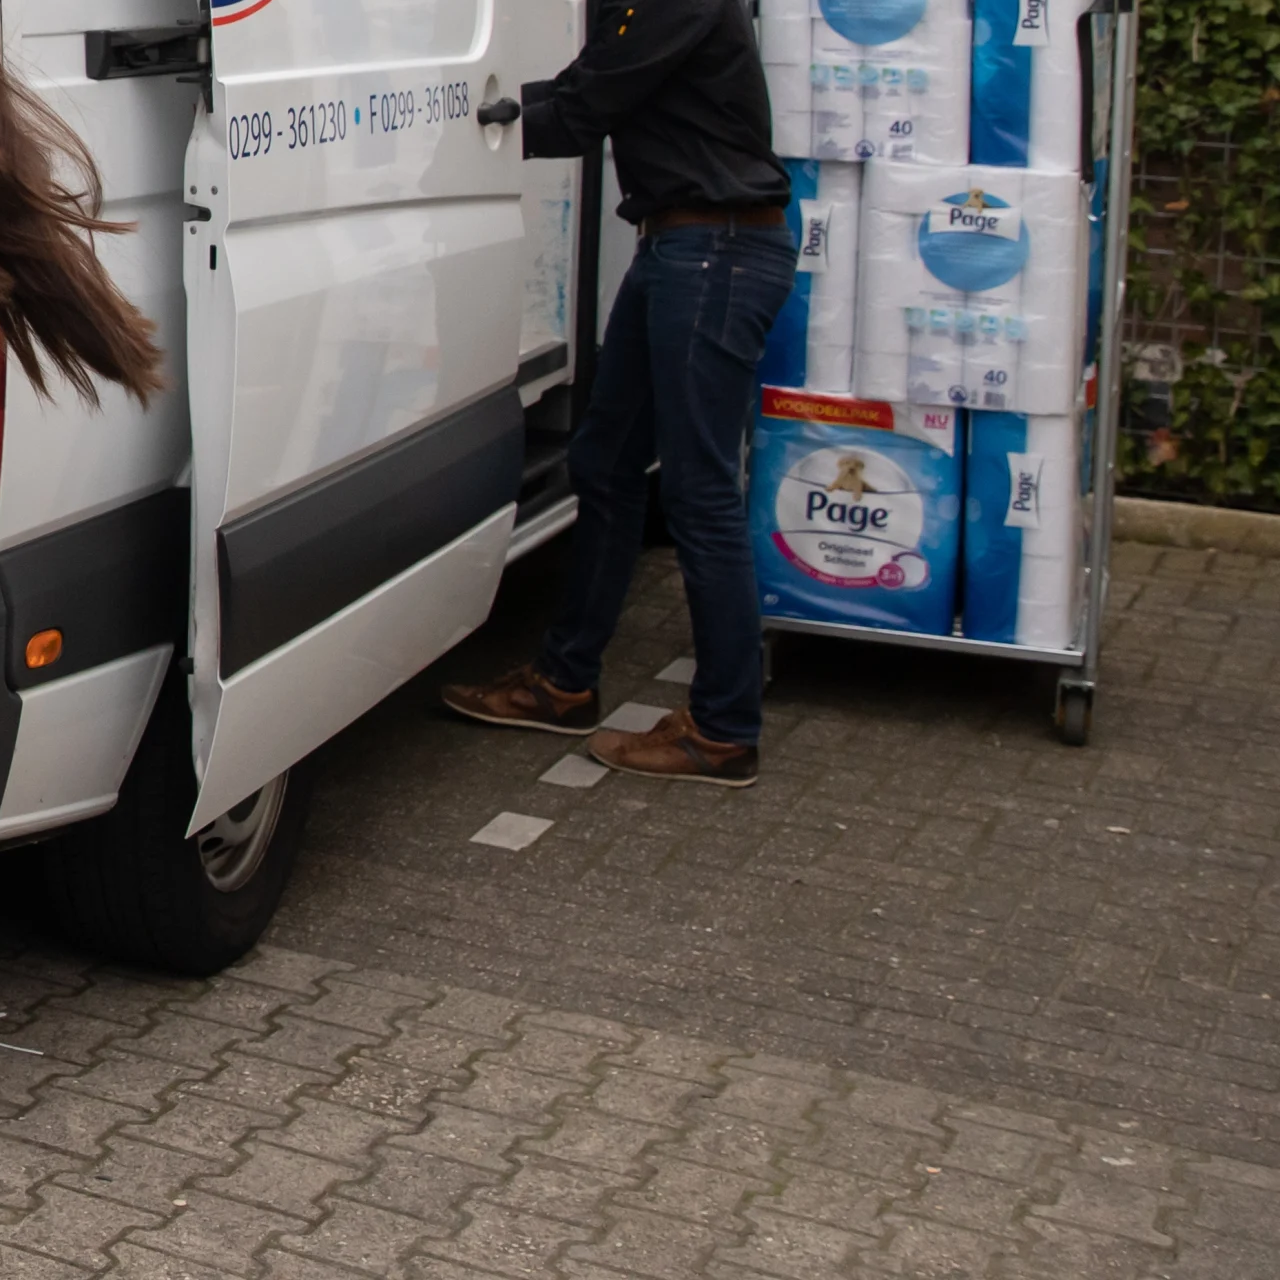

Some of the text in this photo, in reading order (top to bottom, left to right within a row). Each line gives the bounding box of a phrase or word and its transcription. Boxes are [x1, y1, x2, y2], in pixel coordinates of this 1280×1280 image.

[229, 110, 272, 160] 0299
[287, 100, 347, 150] 361230
[380, 90, 415, 132] 0299
[425, 81, 469, 125] 361058
[889, 120, 913, 136] 40
[949, 207, 999, 231] Page
[803, 217, 824, 257] Page
[983, 370, 1007, 385] 40
[924, 413, 948, 428] NU
[1013, 470, 1034, 512] Page
[806, 491, 888, 532] Page
